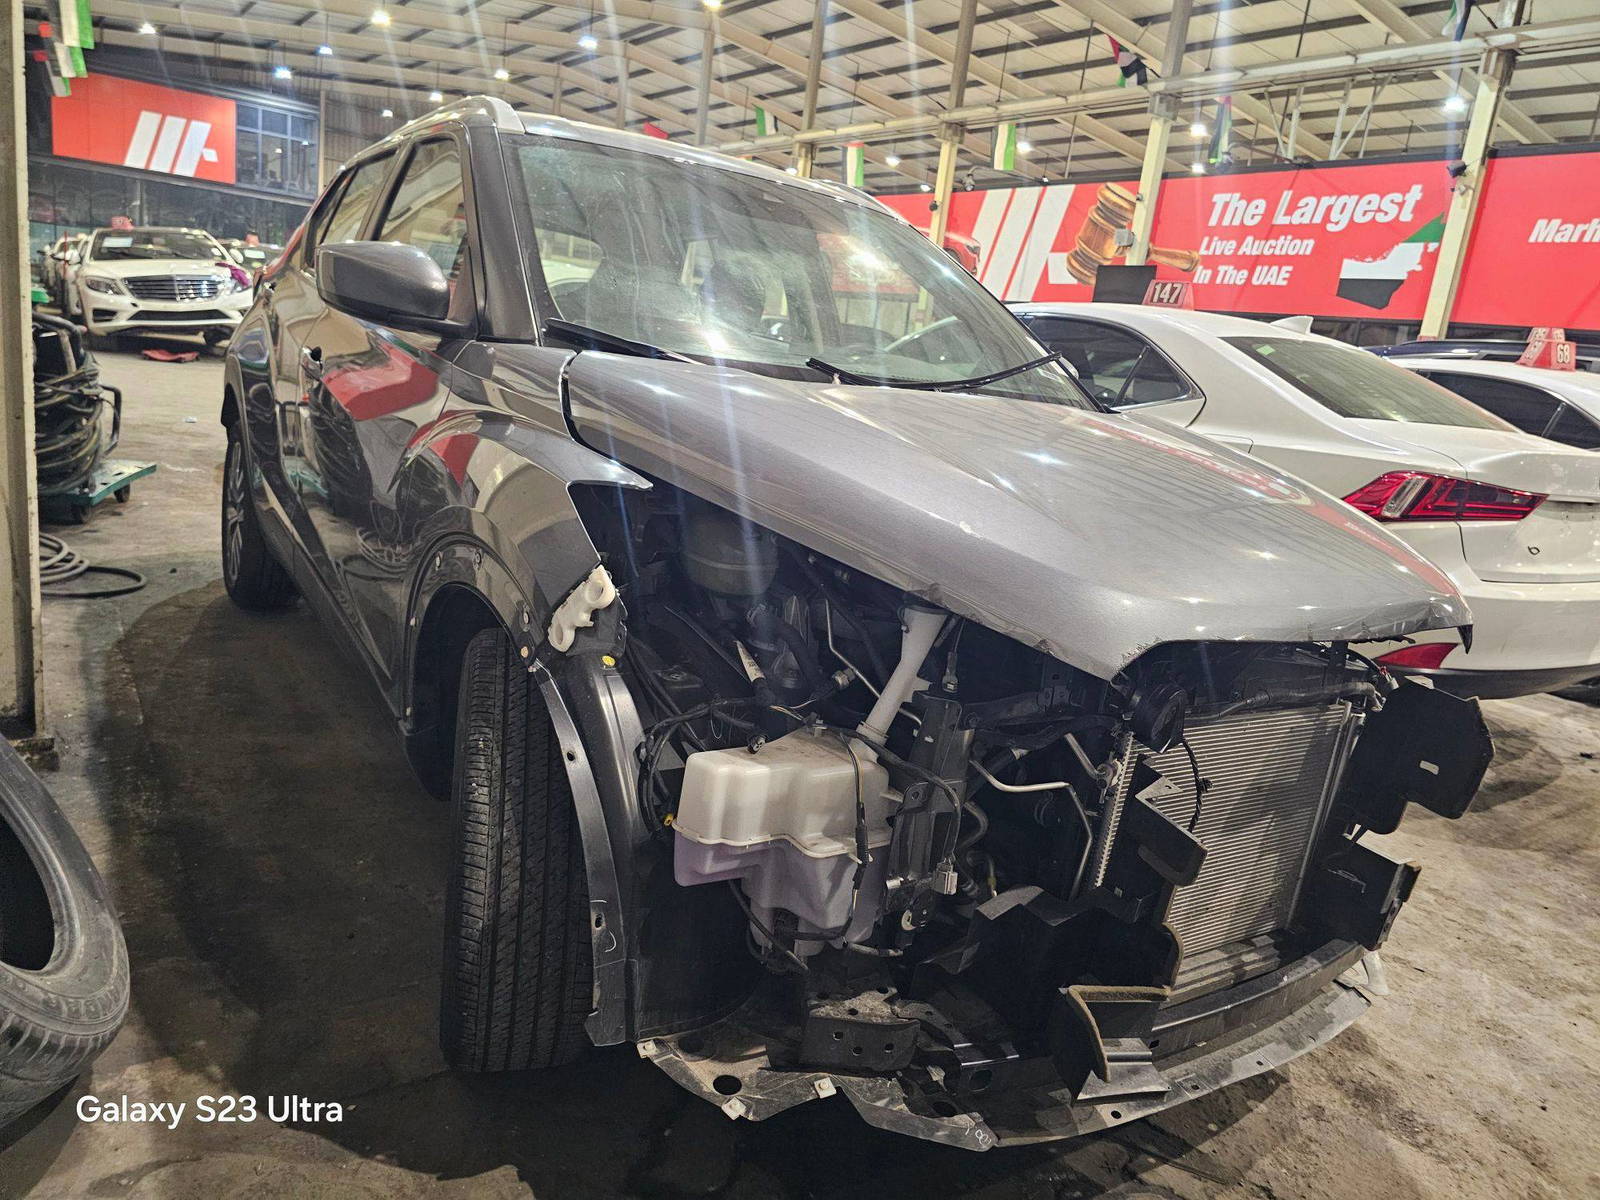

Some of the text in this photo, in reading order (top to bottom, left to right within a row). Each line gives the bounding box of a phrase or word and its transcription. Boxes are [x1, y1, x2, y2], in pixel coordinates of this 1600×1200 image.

[1208, 184, 1423, 232] The Largest
[1199, 235, 1315, 256] Live Auction
[1192, 265, 1293, 286] In The UAE
[1152, 281, 1183, 304] 147
[1557, 343, 1570, 364] 68
